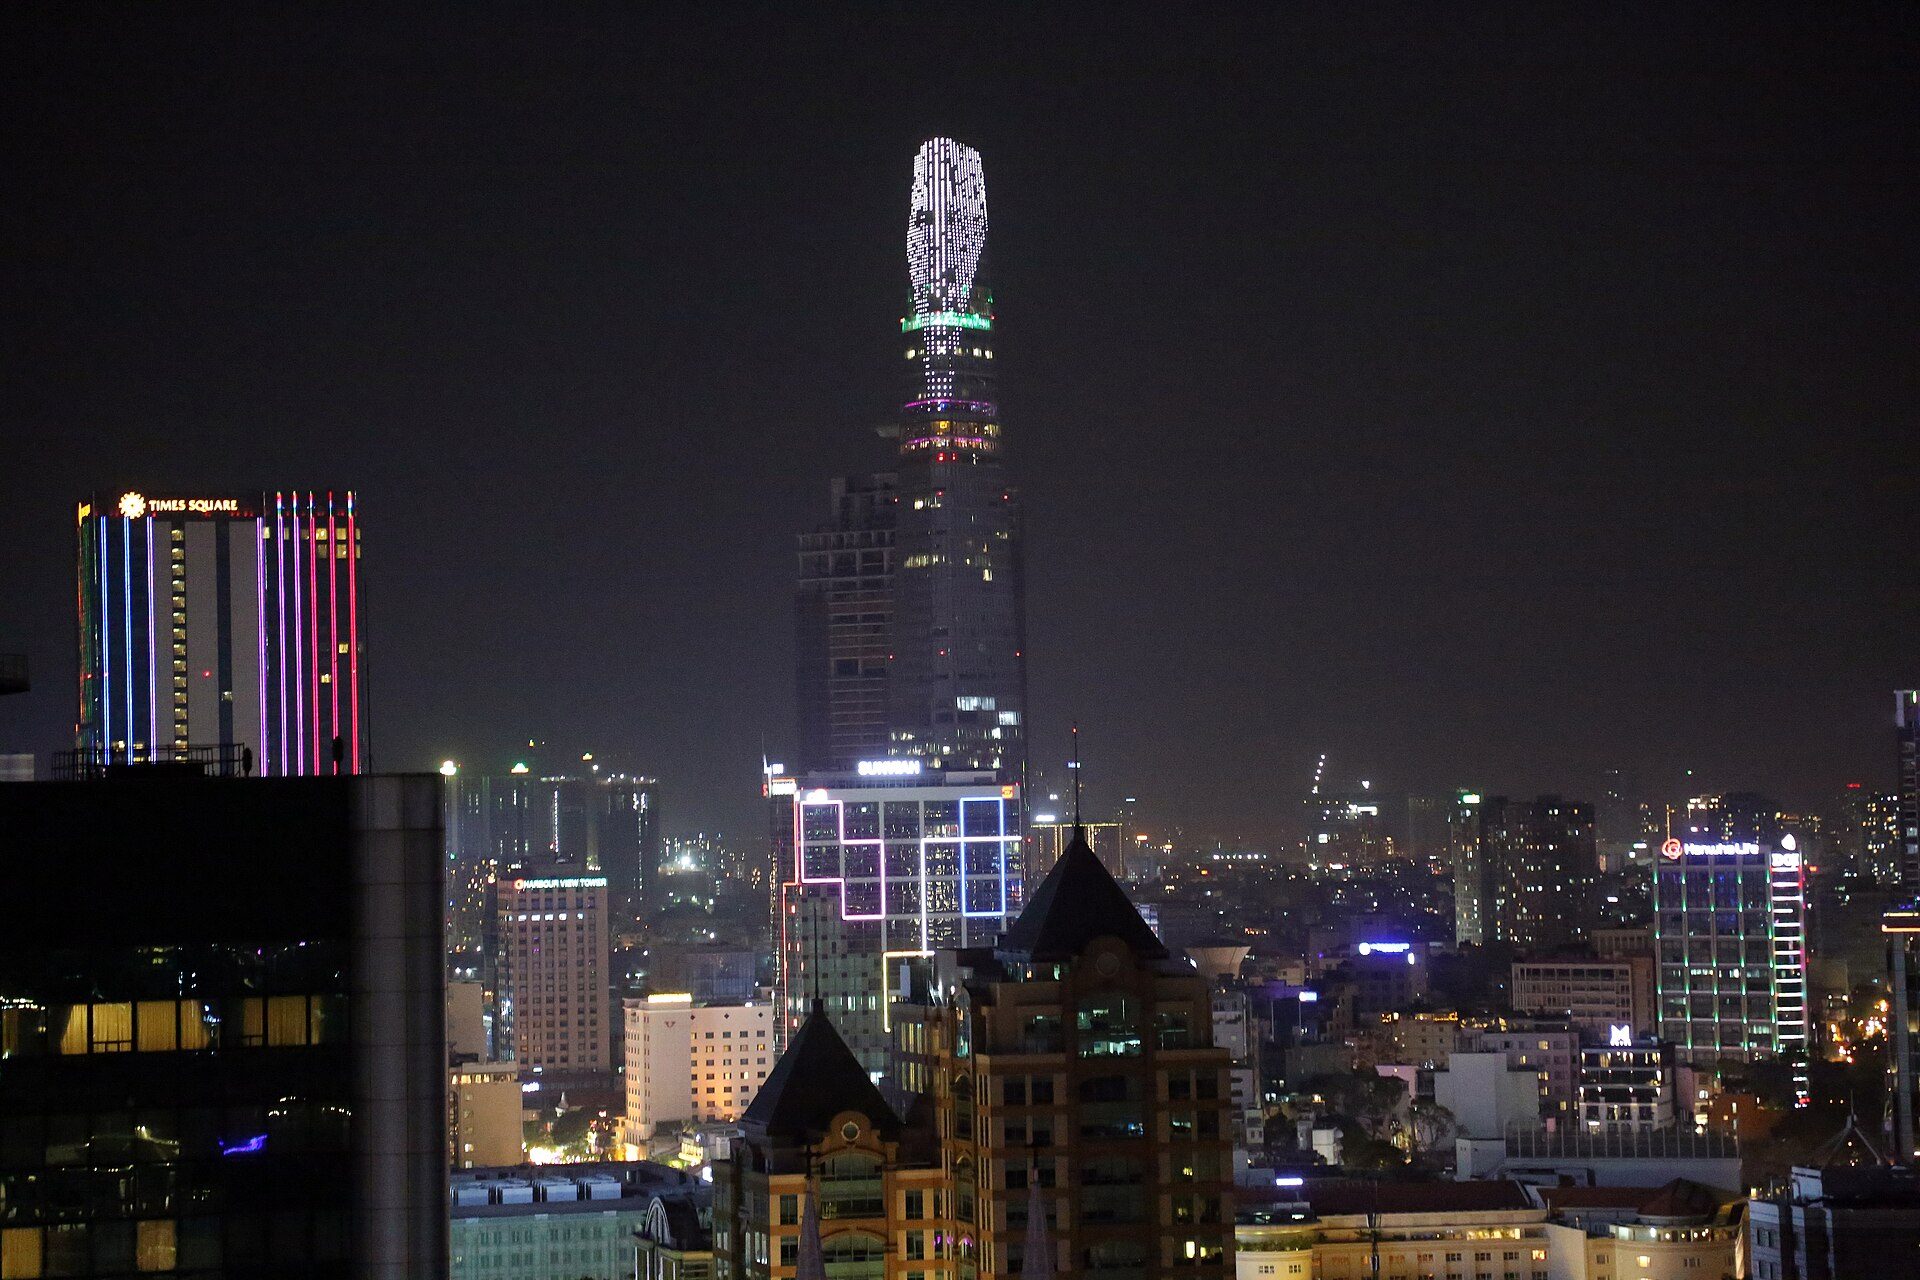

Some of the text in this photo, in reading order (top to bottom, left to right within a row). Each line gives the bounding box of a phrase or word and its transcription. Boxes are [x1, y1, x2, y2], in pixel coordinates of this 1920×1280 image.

[149, 499, 238, 513] TIMES SQUARE
[524, 878, 607, 889] HARBOUR VIEW TOWER
